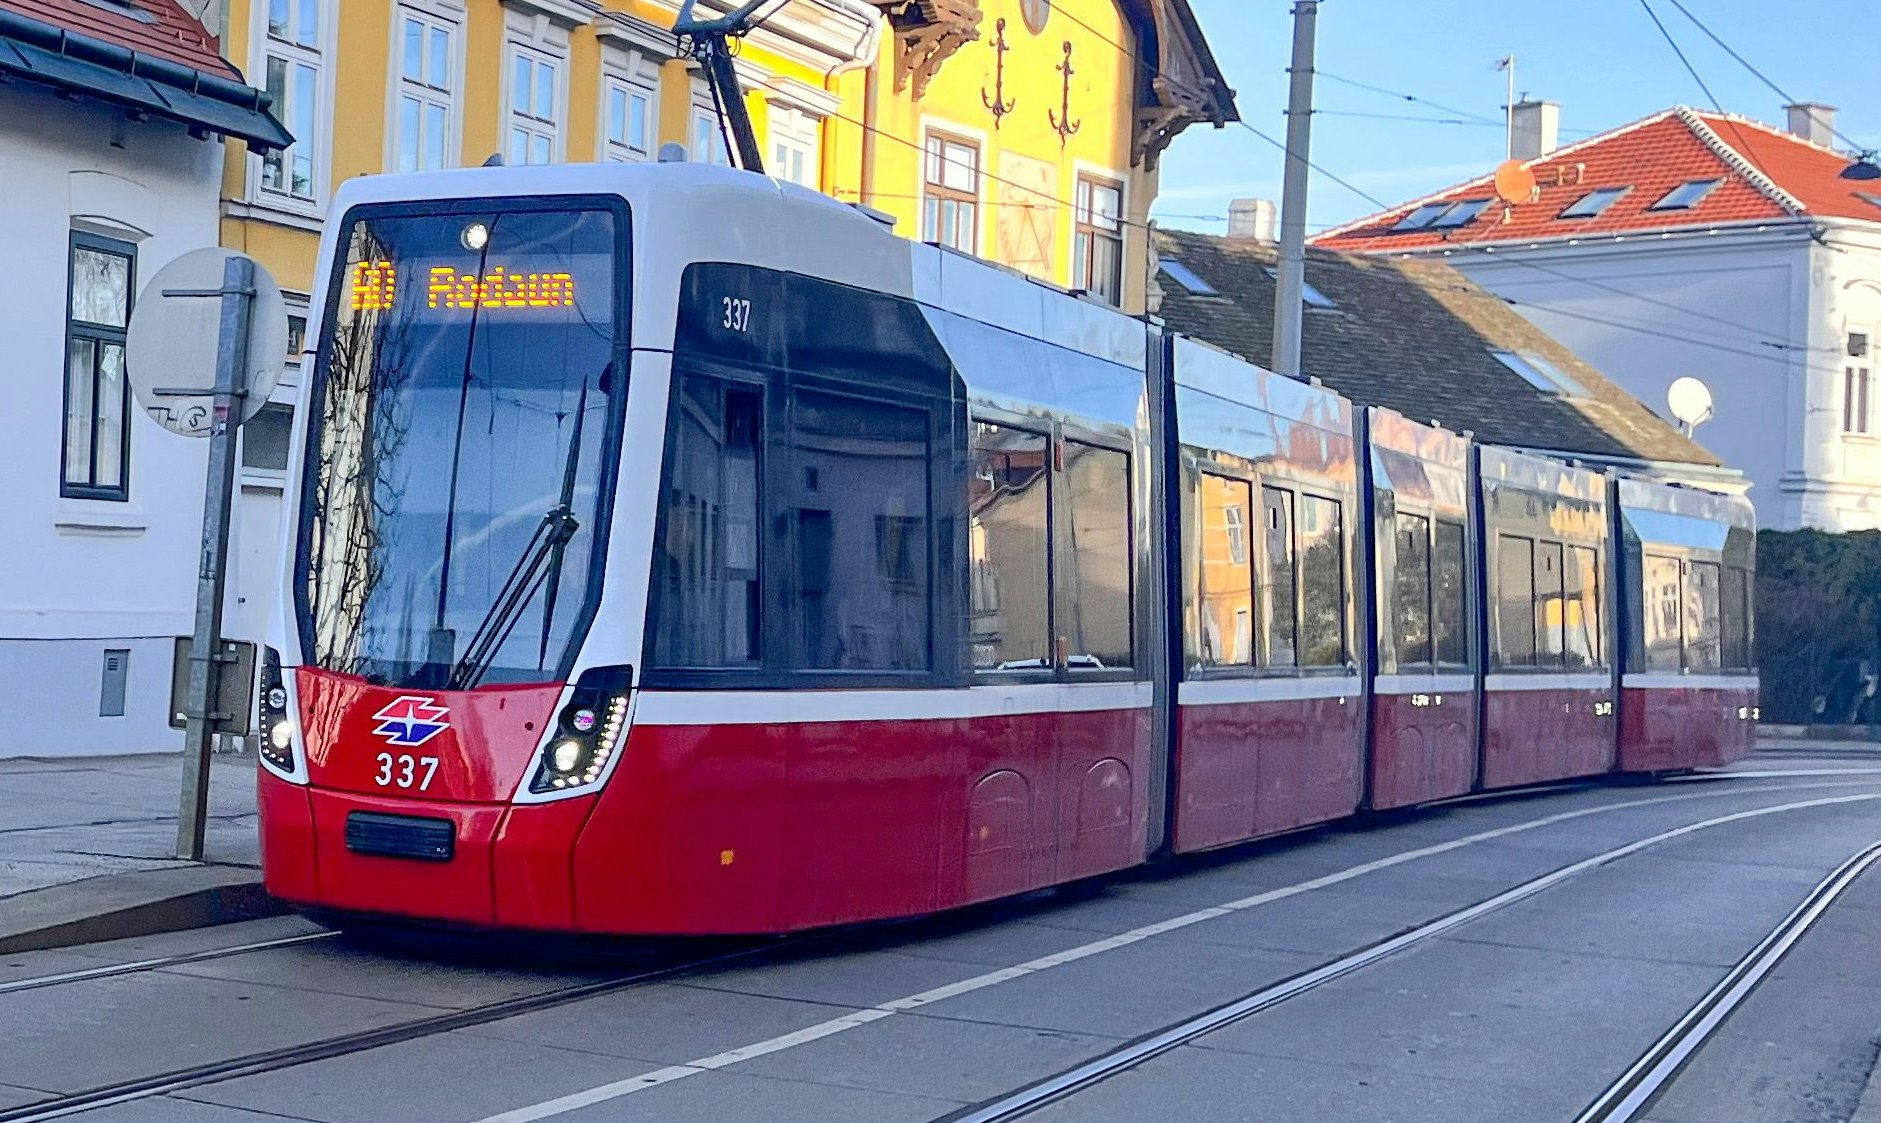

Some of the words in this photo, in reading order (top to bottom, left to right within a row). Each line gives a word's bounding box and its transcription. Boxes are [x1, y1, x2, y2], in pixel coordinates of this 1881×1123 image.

[428, 266, 573, 308] Rodaun
[723, 296, 751, 332] 337
[375, 752, 439, 791] 337
